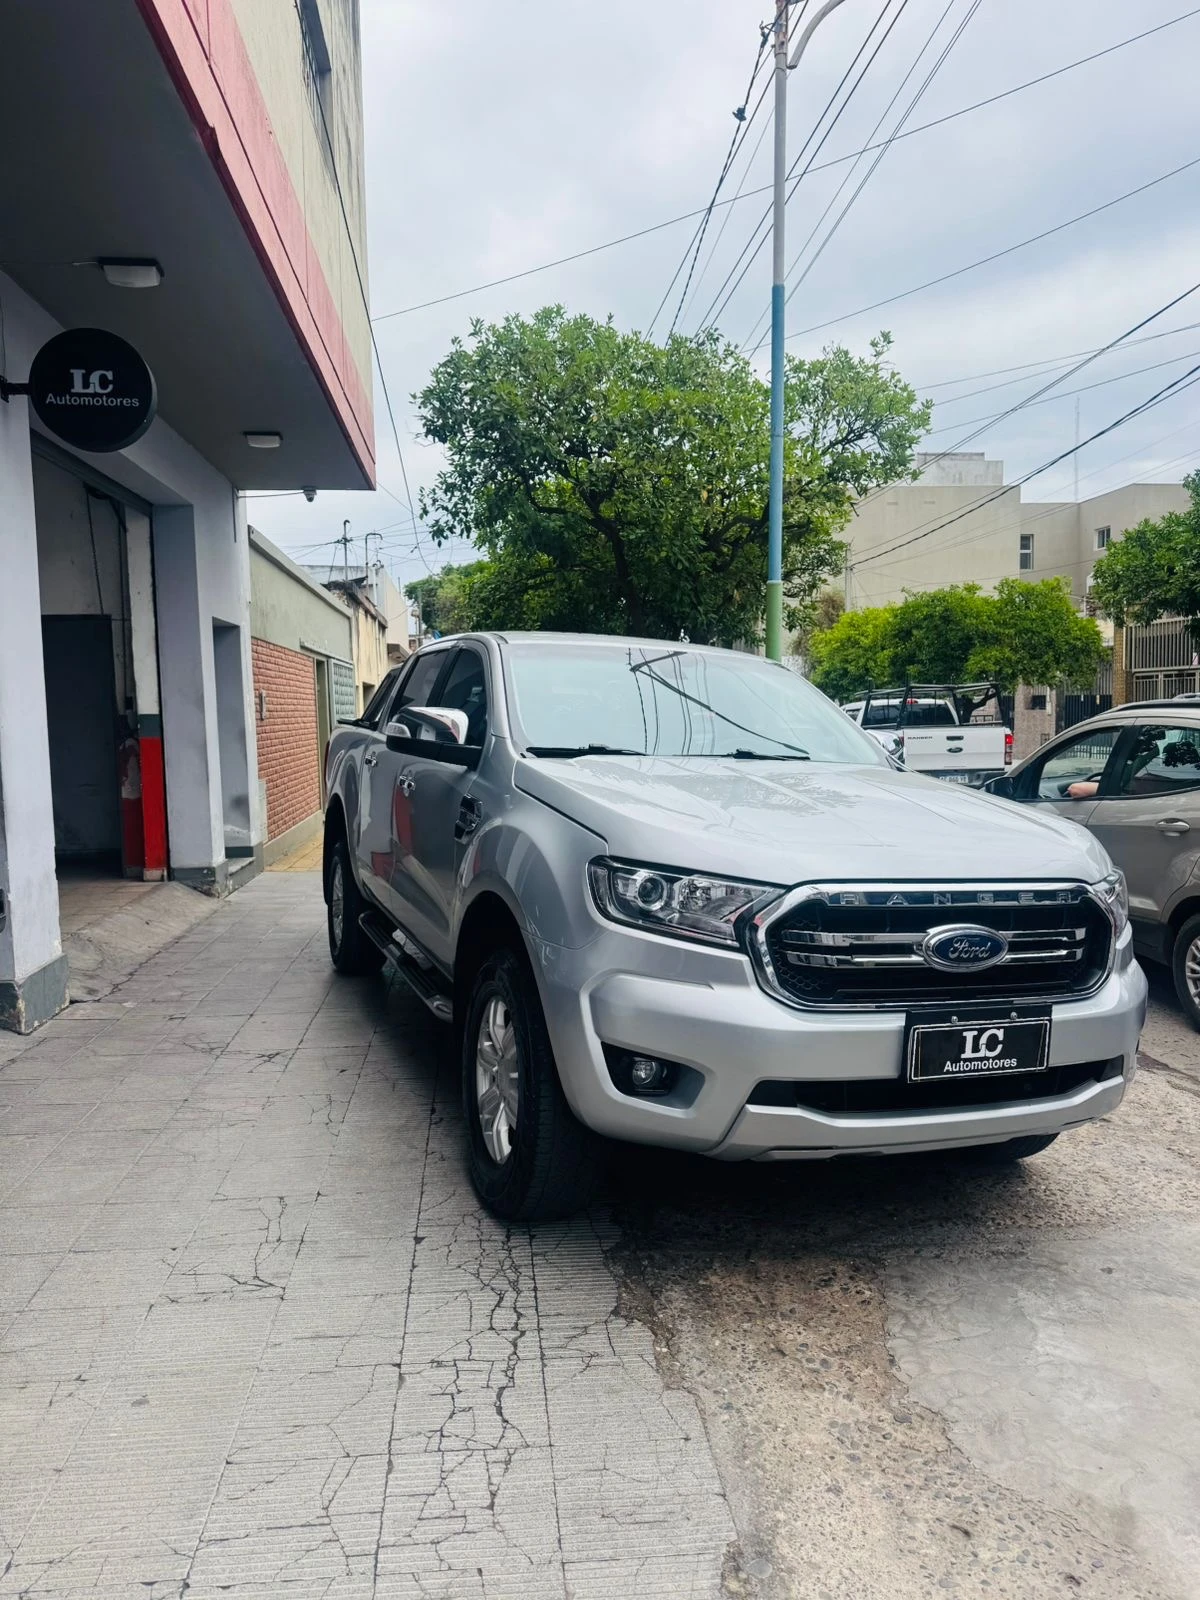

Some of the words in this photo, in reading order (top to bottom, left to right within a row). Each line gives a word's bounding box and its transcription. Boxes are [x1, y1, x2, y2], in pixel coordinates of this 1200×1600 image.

[70, 369, 113, 394] LC
[46, 394, 139, 407] Automotores
[840, 891, 1071, 905] RANGER
[949, 936, 991, 959] Ford
[960, 1028, 1004, 1059] LC
[944, 1058, 1017, 1072] Automotores
